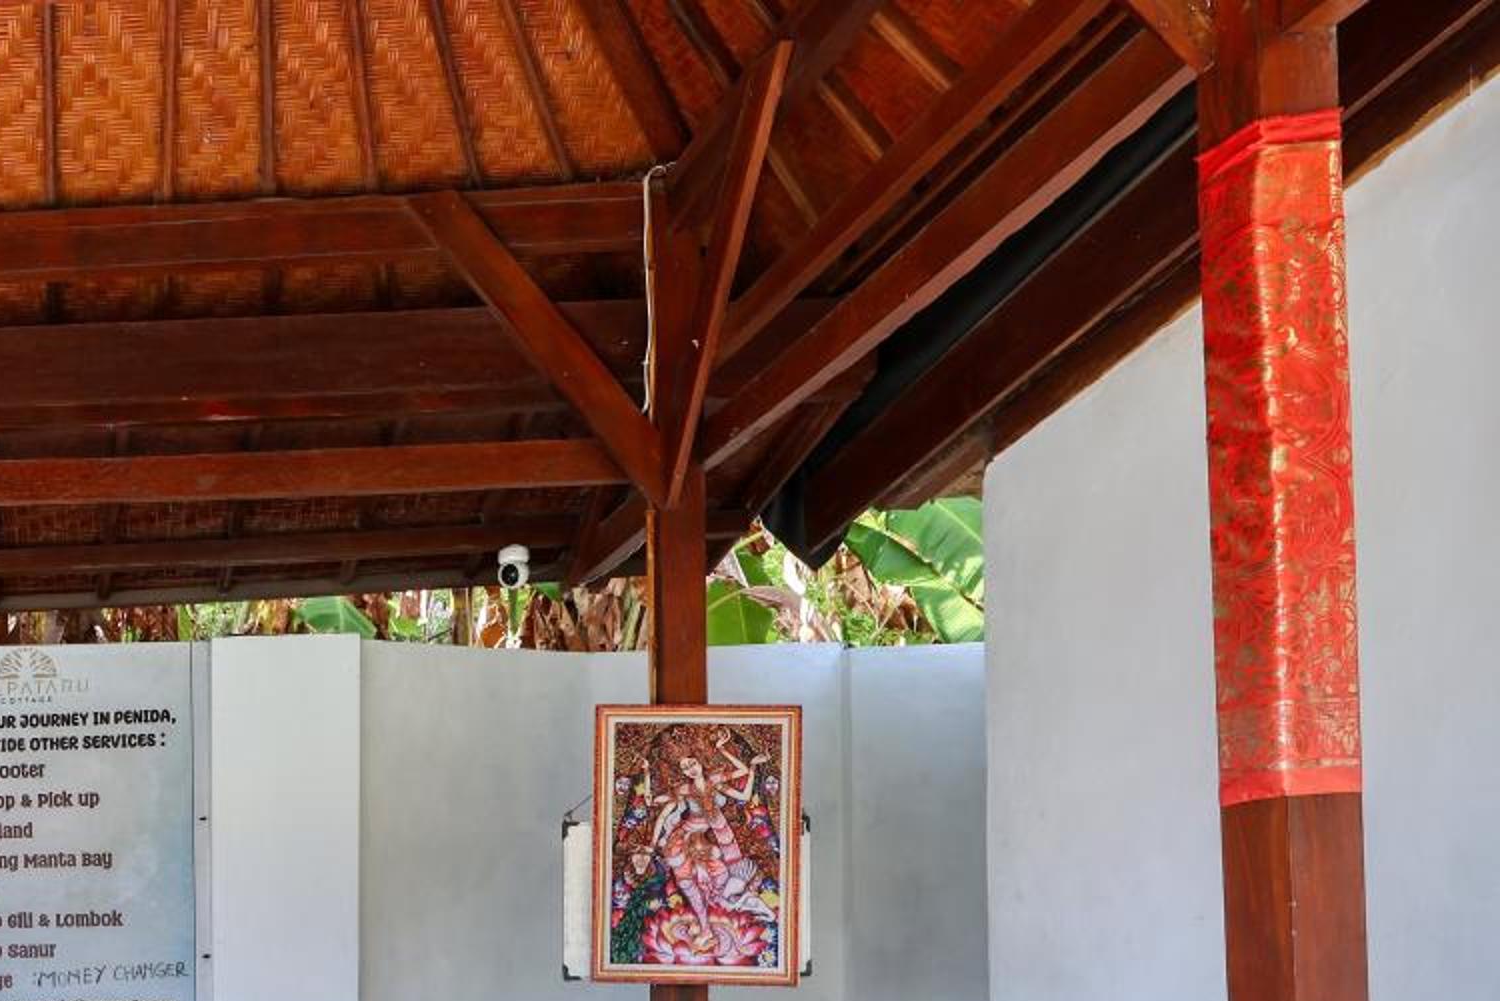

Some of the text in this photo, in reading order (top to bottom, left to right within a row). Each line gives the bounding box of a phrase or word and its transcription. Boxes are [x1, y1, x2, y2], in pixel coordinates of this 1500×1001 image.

[19, 712, 88, 729] JOURNEY
[93, 711, 110, 725] IN
[114, 709, 177, 724] PENIDA,
[30, 736, 79, 751] OTHER
[82, 733, 157, 749] SERVICES
[21, 794, 33, 808] &
[37, 791, 73, 808] Pick
[24, 852, 76, 869] Manta
[81, 852, 112, 869] Bay
[7, 911, 33, 929] Gili
[38, 913, 51, 927] &
[55, 909, 123, 928] Lombok
[113, 961, 189, 982] CHANGER
